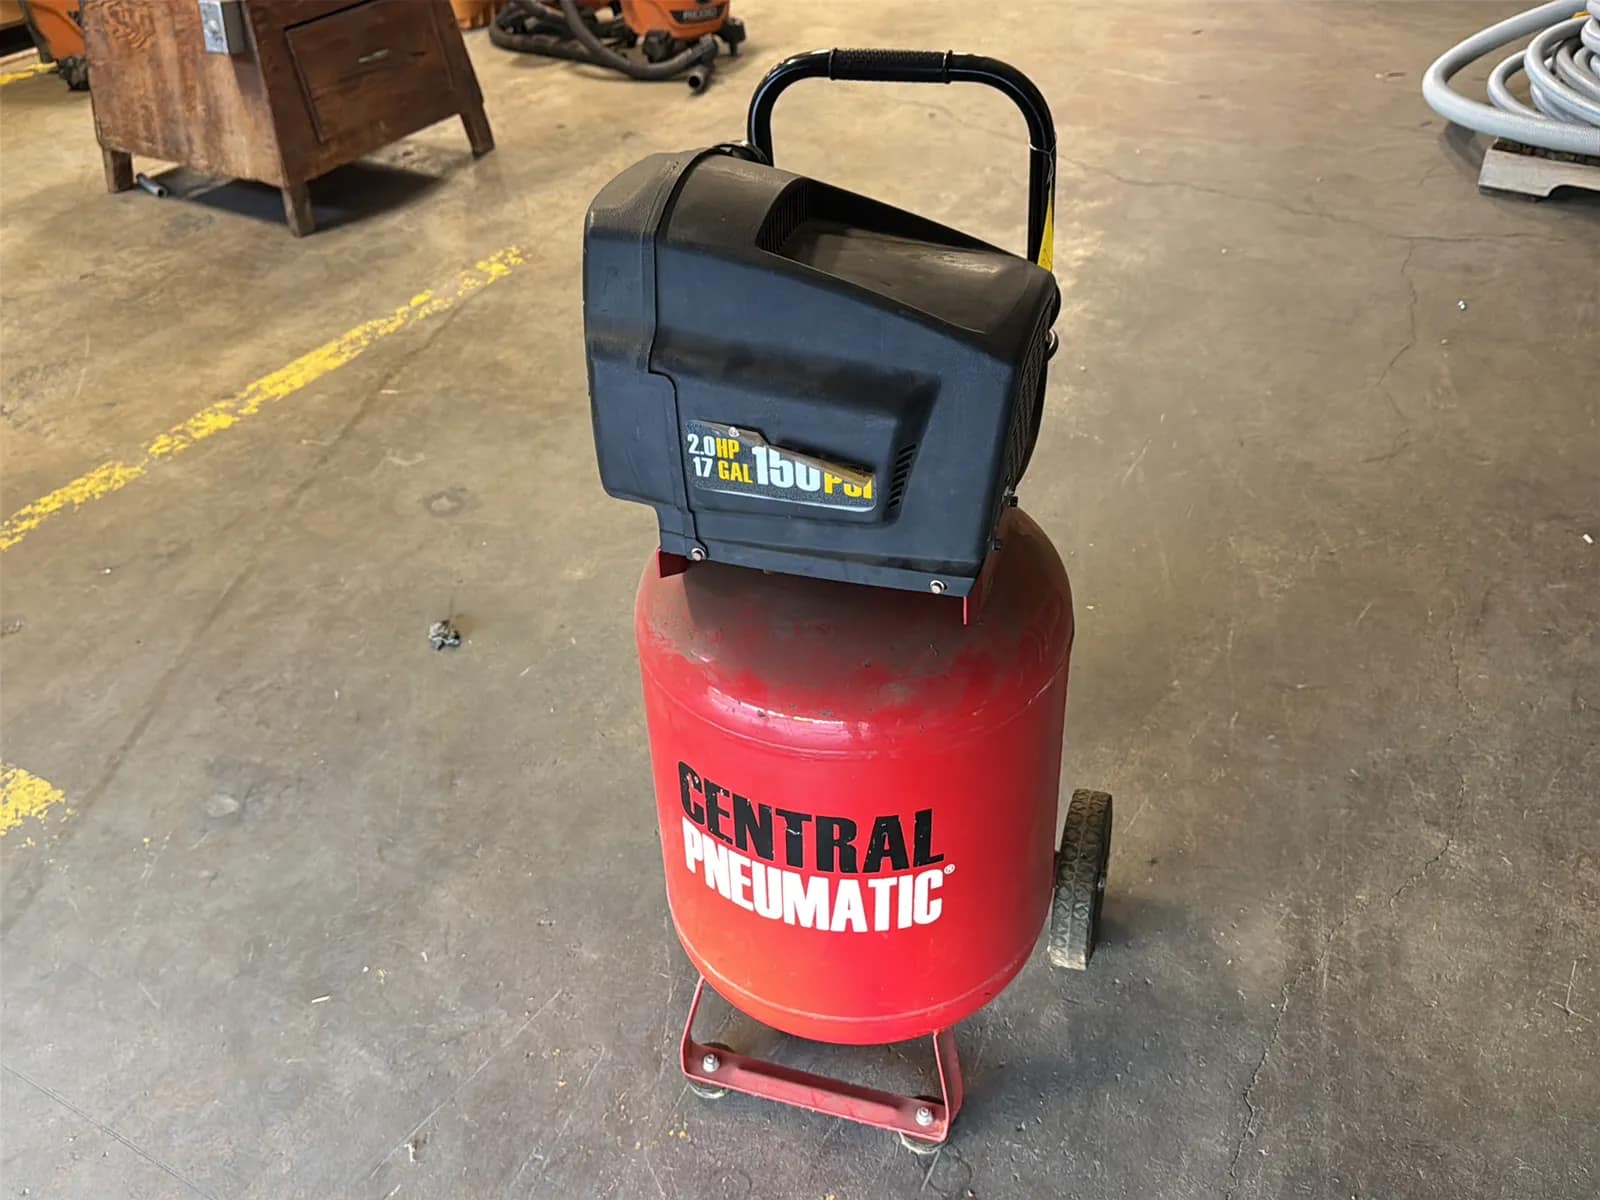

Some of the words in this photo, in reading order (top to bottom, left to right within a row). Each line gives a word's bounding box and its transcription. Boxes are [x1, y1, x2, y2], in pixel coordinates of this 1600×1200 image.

[692, 456, 713, 477] 17
[718, 460, 753, 483] GAL
[678, 760, 945, 873] CENTRAL
